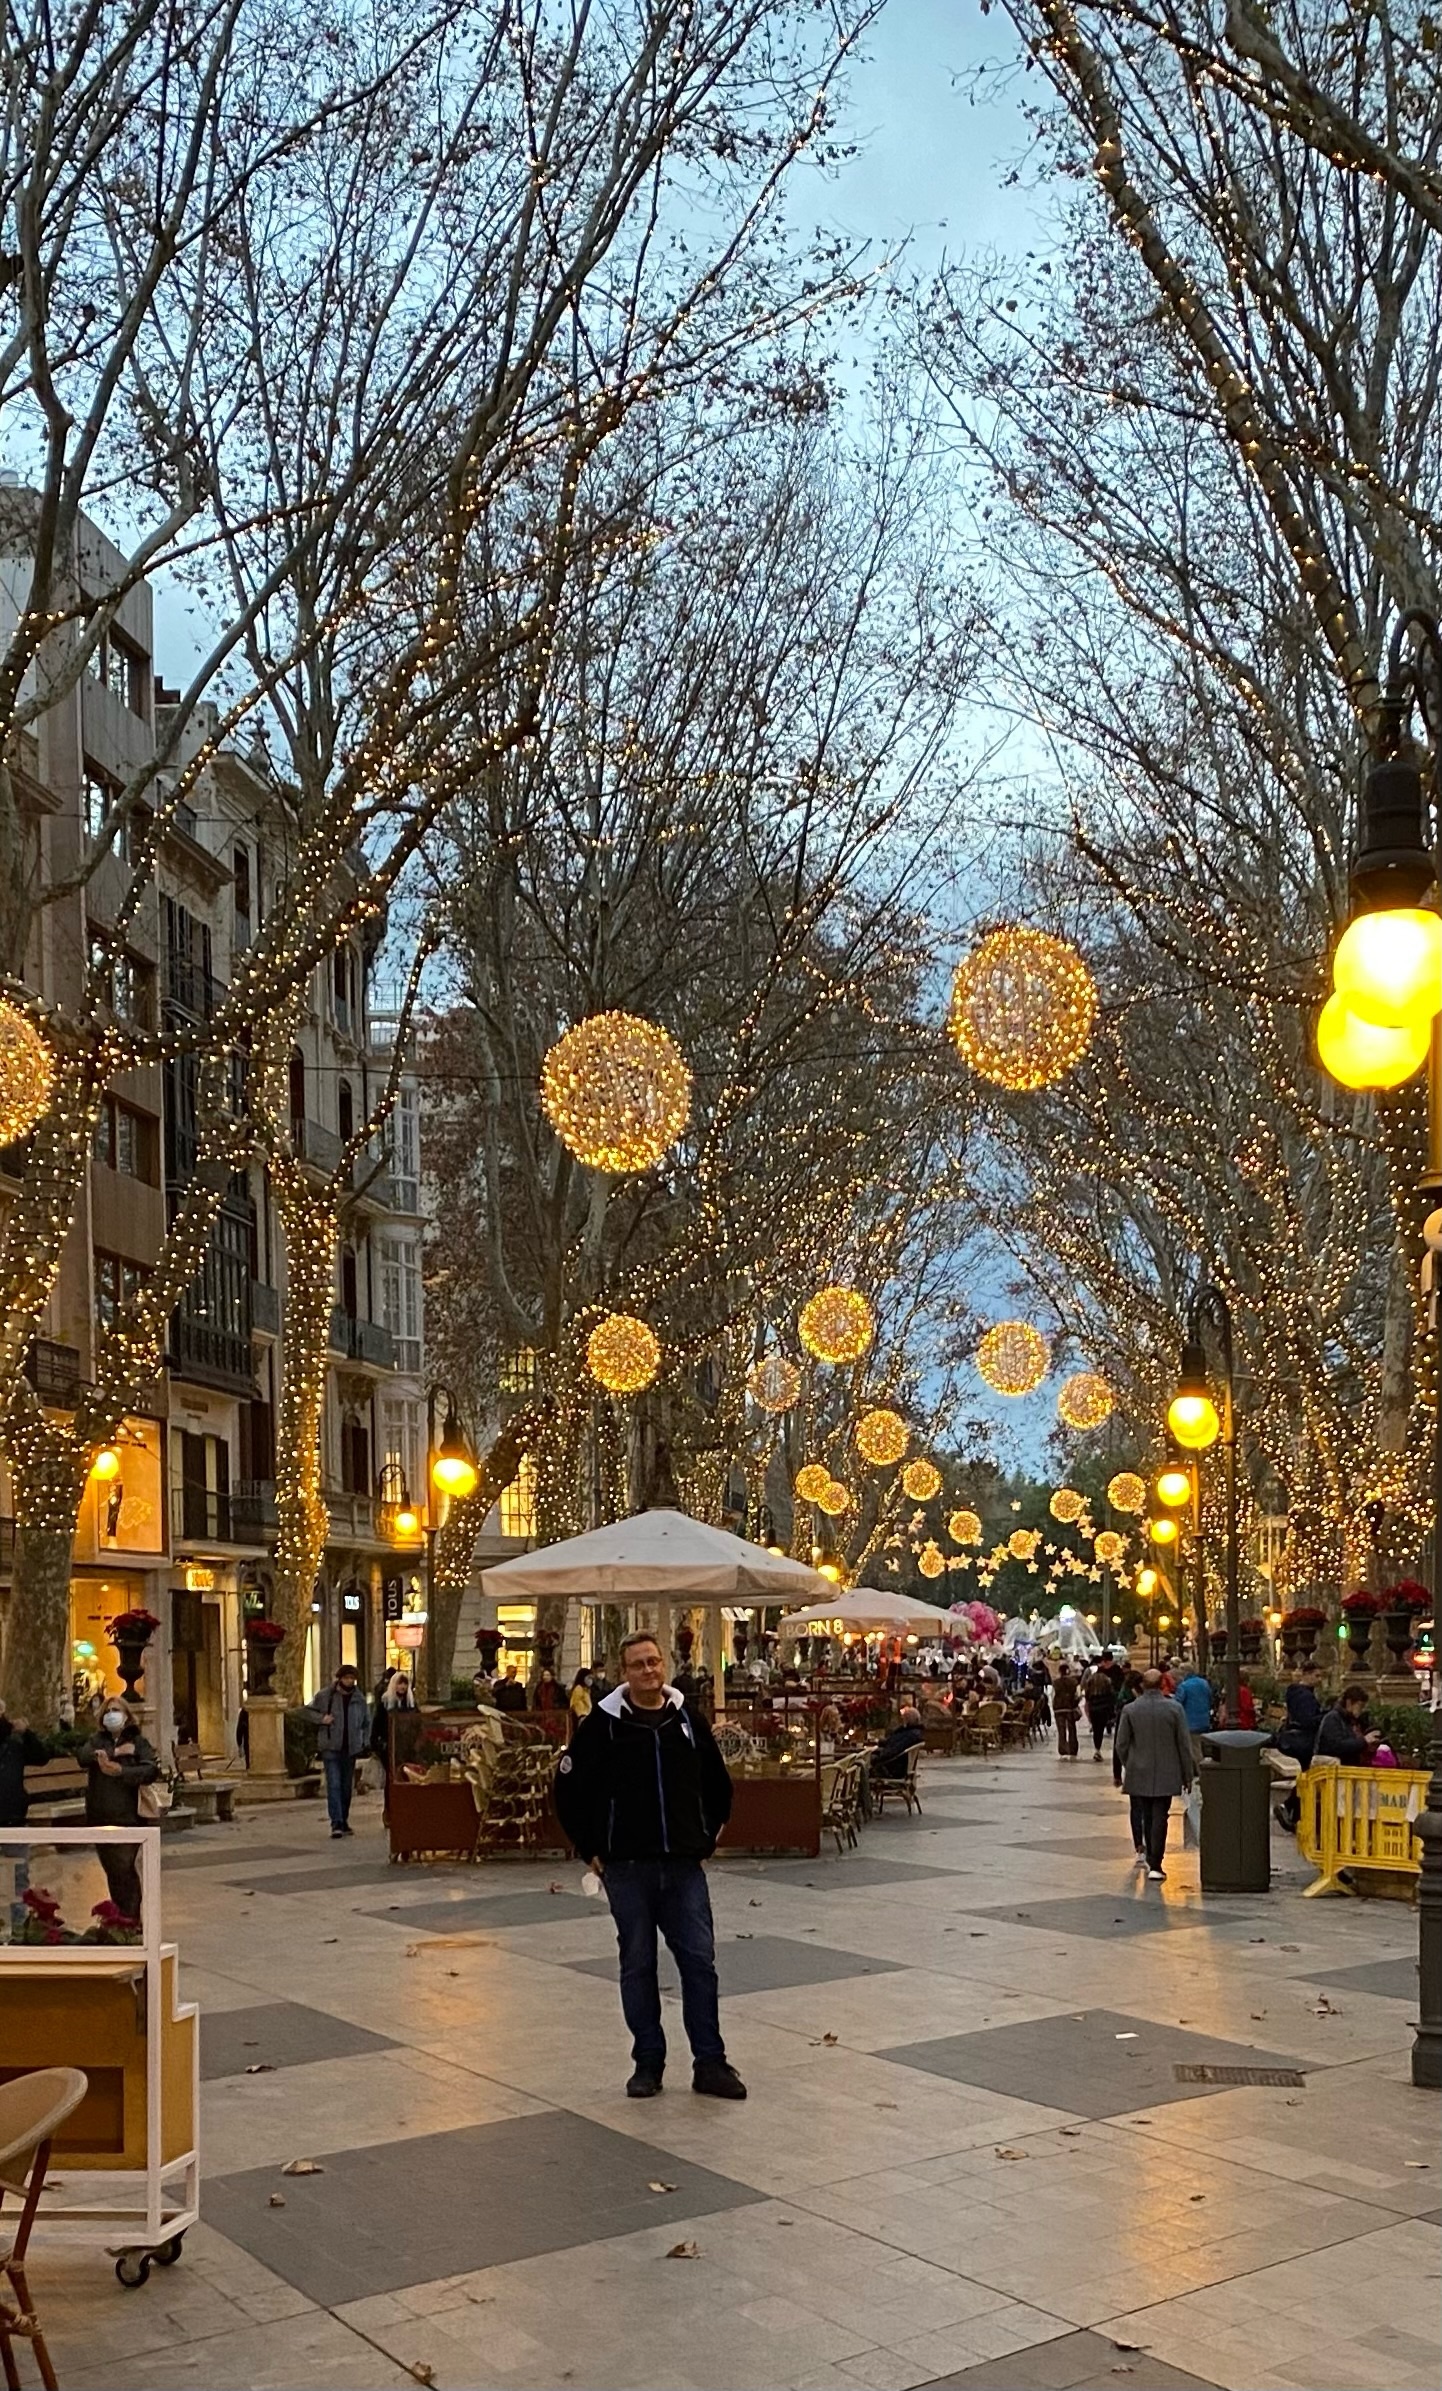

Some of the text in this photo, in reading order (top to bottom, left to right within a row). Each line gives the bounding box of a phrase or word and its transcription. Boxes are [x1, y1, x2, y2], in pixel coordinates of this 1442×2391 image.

[388, 1580, 398, 1617] TOUS
[786, 1618, 844, 1637] BORN 8
